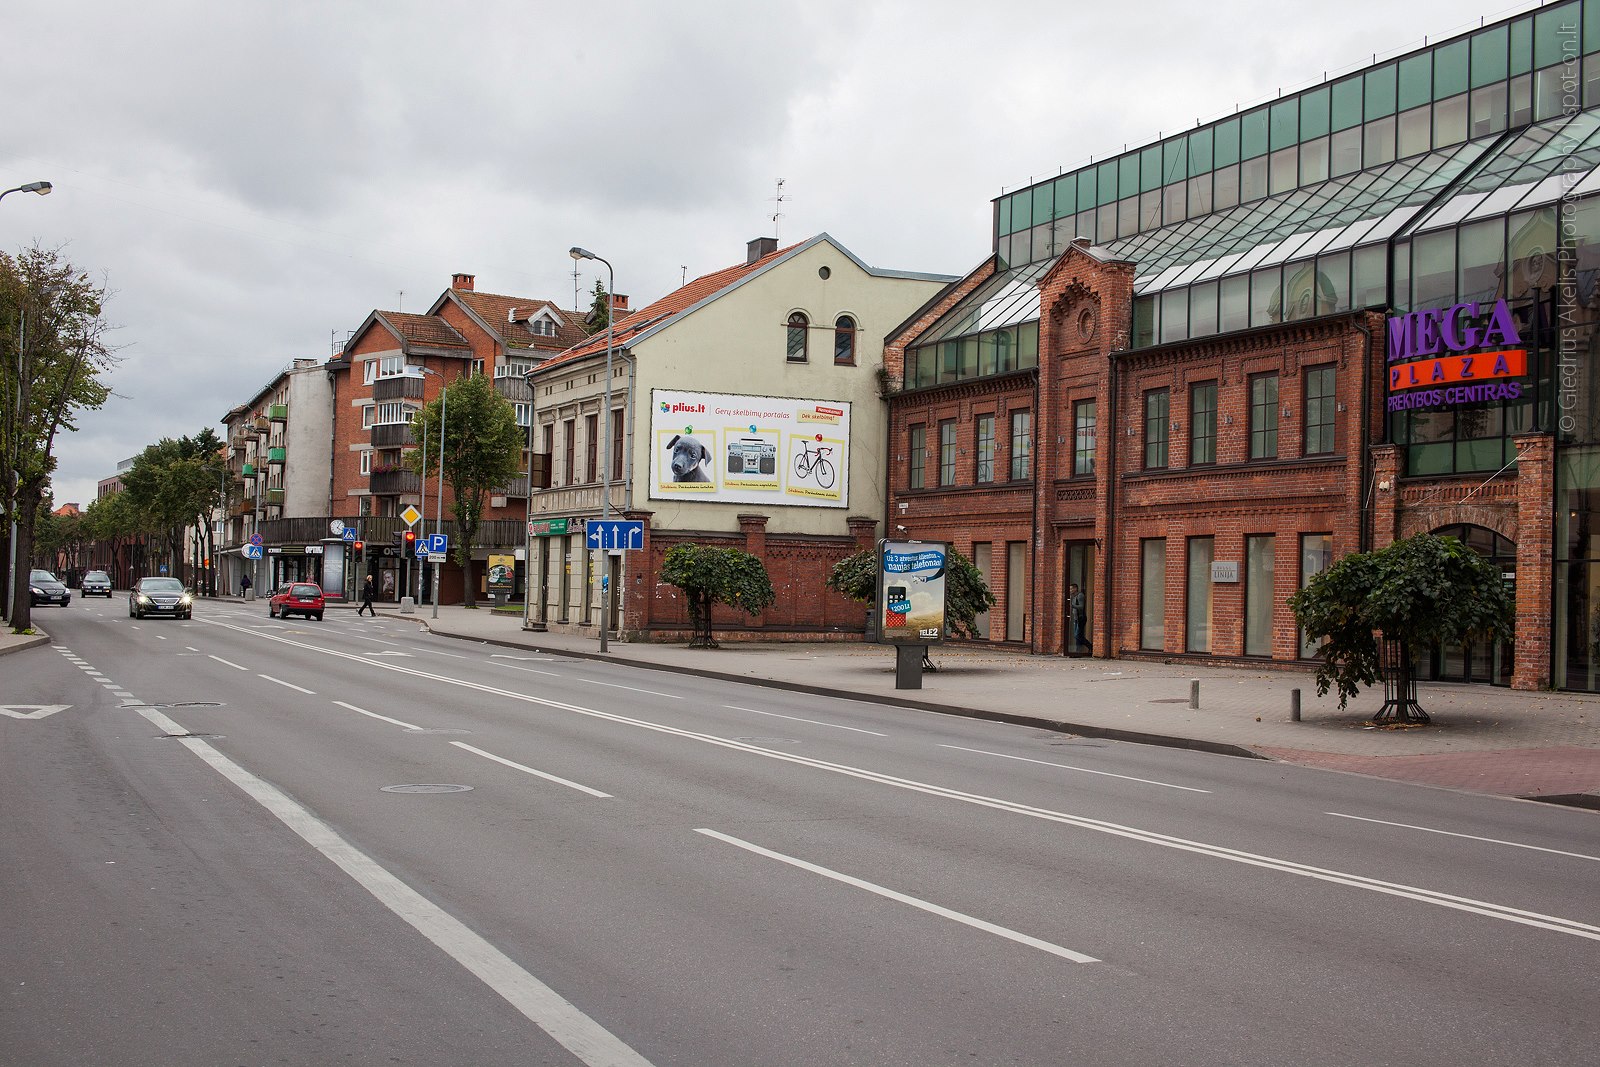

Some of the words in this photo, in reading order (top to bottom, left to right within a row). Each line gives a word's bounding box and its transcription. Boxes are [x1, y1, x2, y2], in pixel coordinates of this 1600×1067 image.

[1388, 298, 1521, 361] MEGA
[1392, 354, 1510, 388] PLAZA
[1388, 388, 1441, 412] PREKYBOS
[1445, 382, 1523, 405] CENTRAS
[672, 403, 706, 414] plius.lt
[715, 407, 731, 416] Gerų
[732, 408, 762, 418] skelbimų
[763, 411, 790, 419] portalas
[433, 536, 444, 550] P
[888, 562, 911, 572] naujas
[911, 559, 942, 570] telefonas!
[919, 627, 938, 636] TELE2
